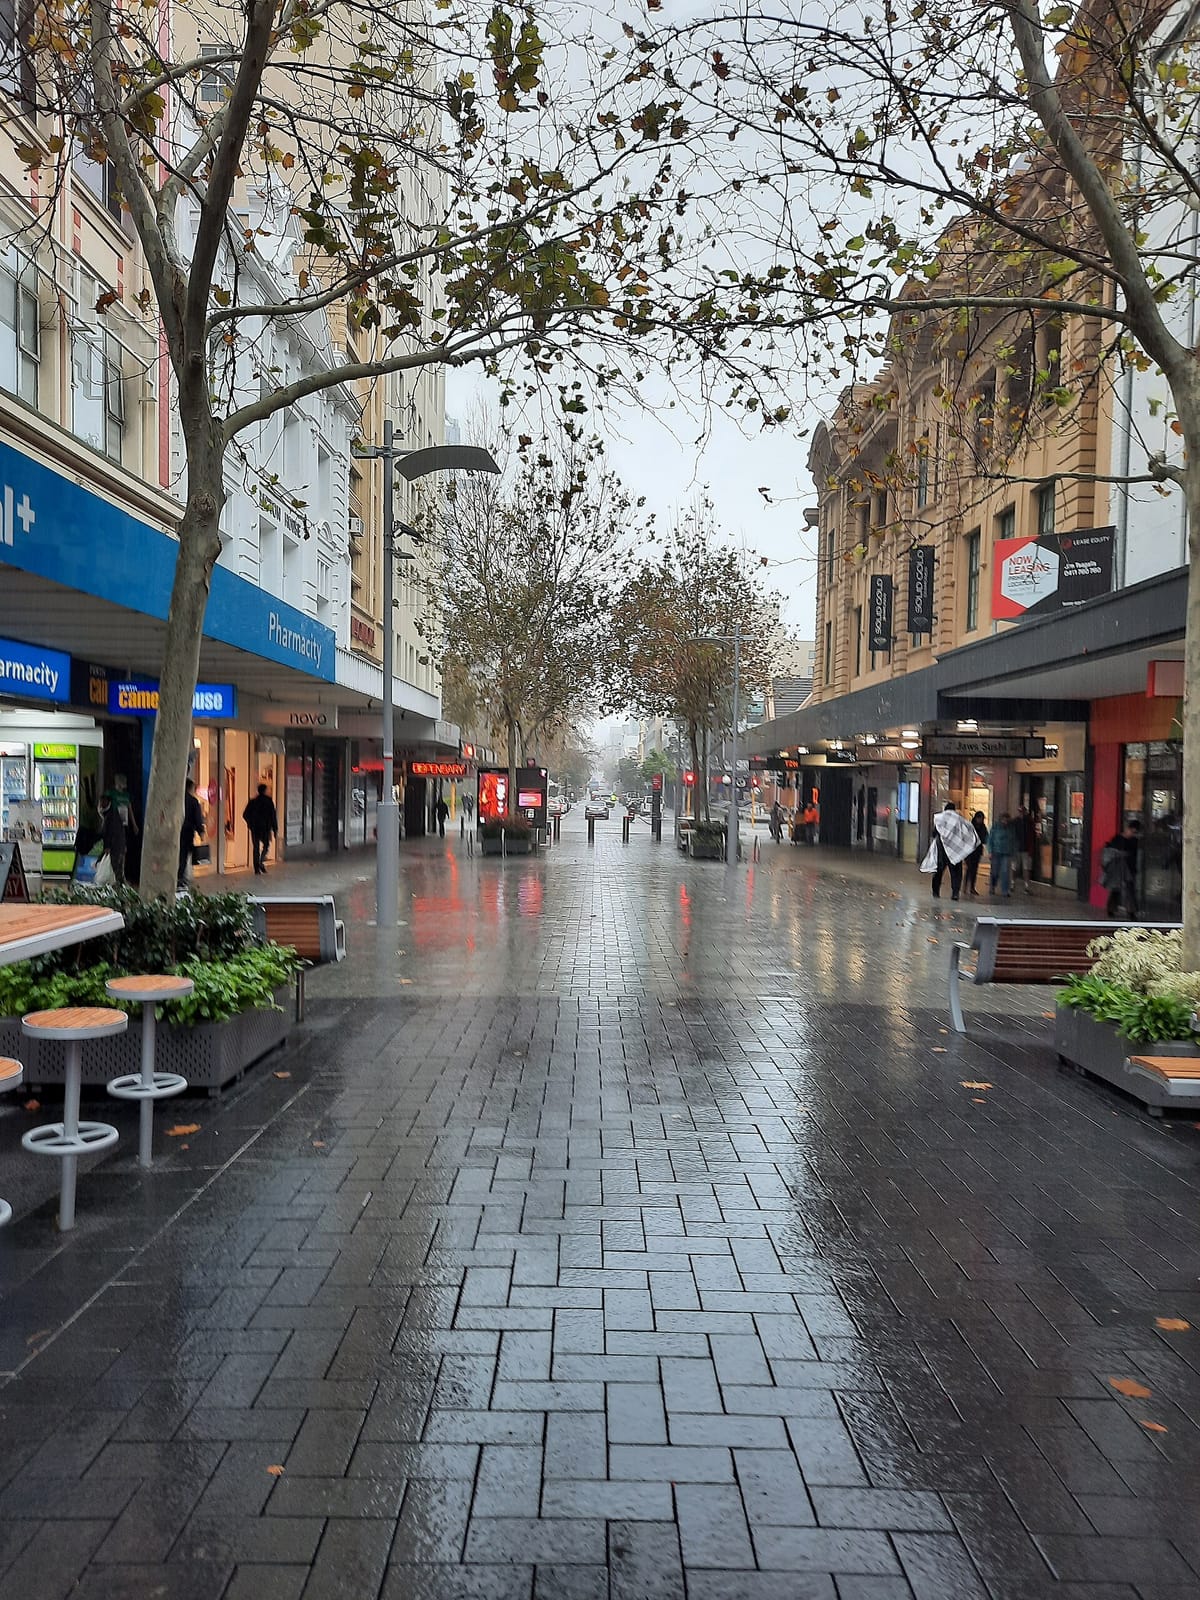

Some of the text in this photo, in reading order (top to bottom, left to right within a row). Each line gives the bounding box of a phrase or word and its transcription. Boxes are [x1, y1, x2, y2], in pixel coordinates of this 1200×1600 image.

[1008, 556, 1032, 566] NOW
[1008, 563, 1051, 575] LEASING
[915, 549, 924, 614] SOLID GOLD
[269, 612, 322, 668] Pharmacity
[289, 713, 327, 726] novo
[957, 741, 979, 751] Jaws
[981, 741, 1007, 751] Sushi
